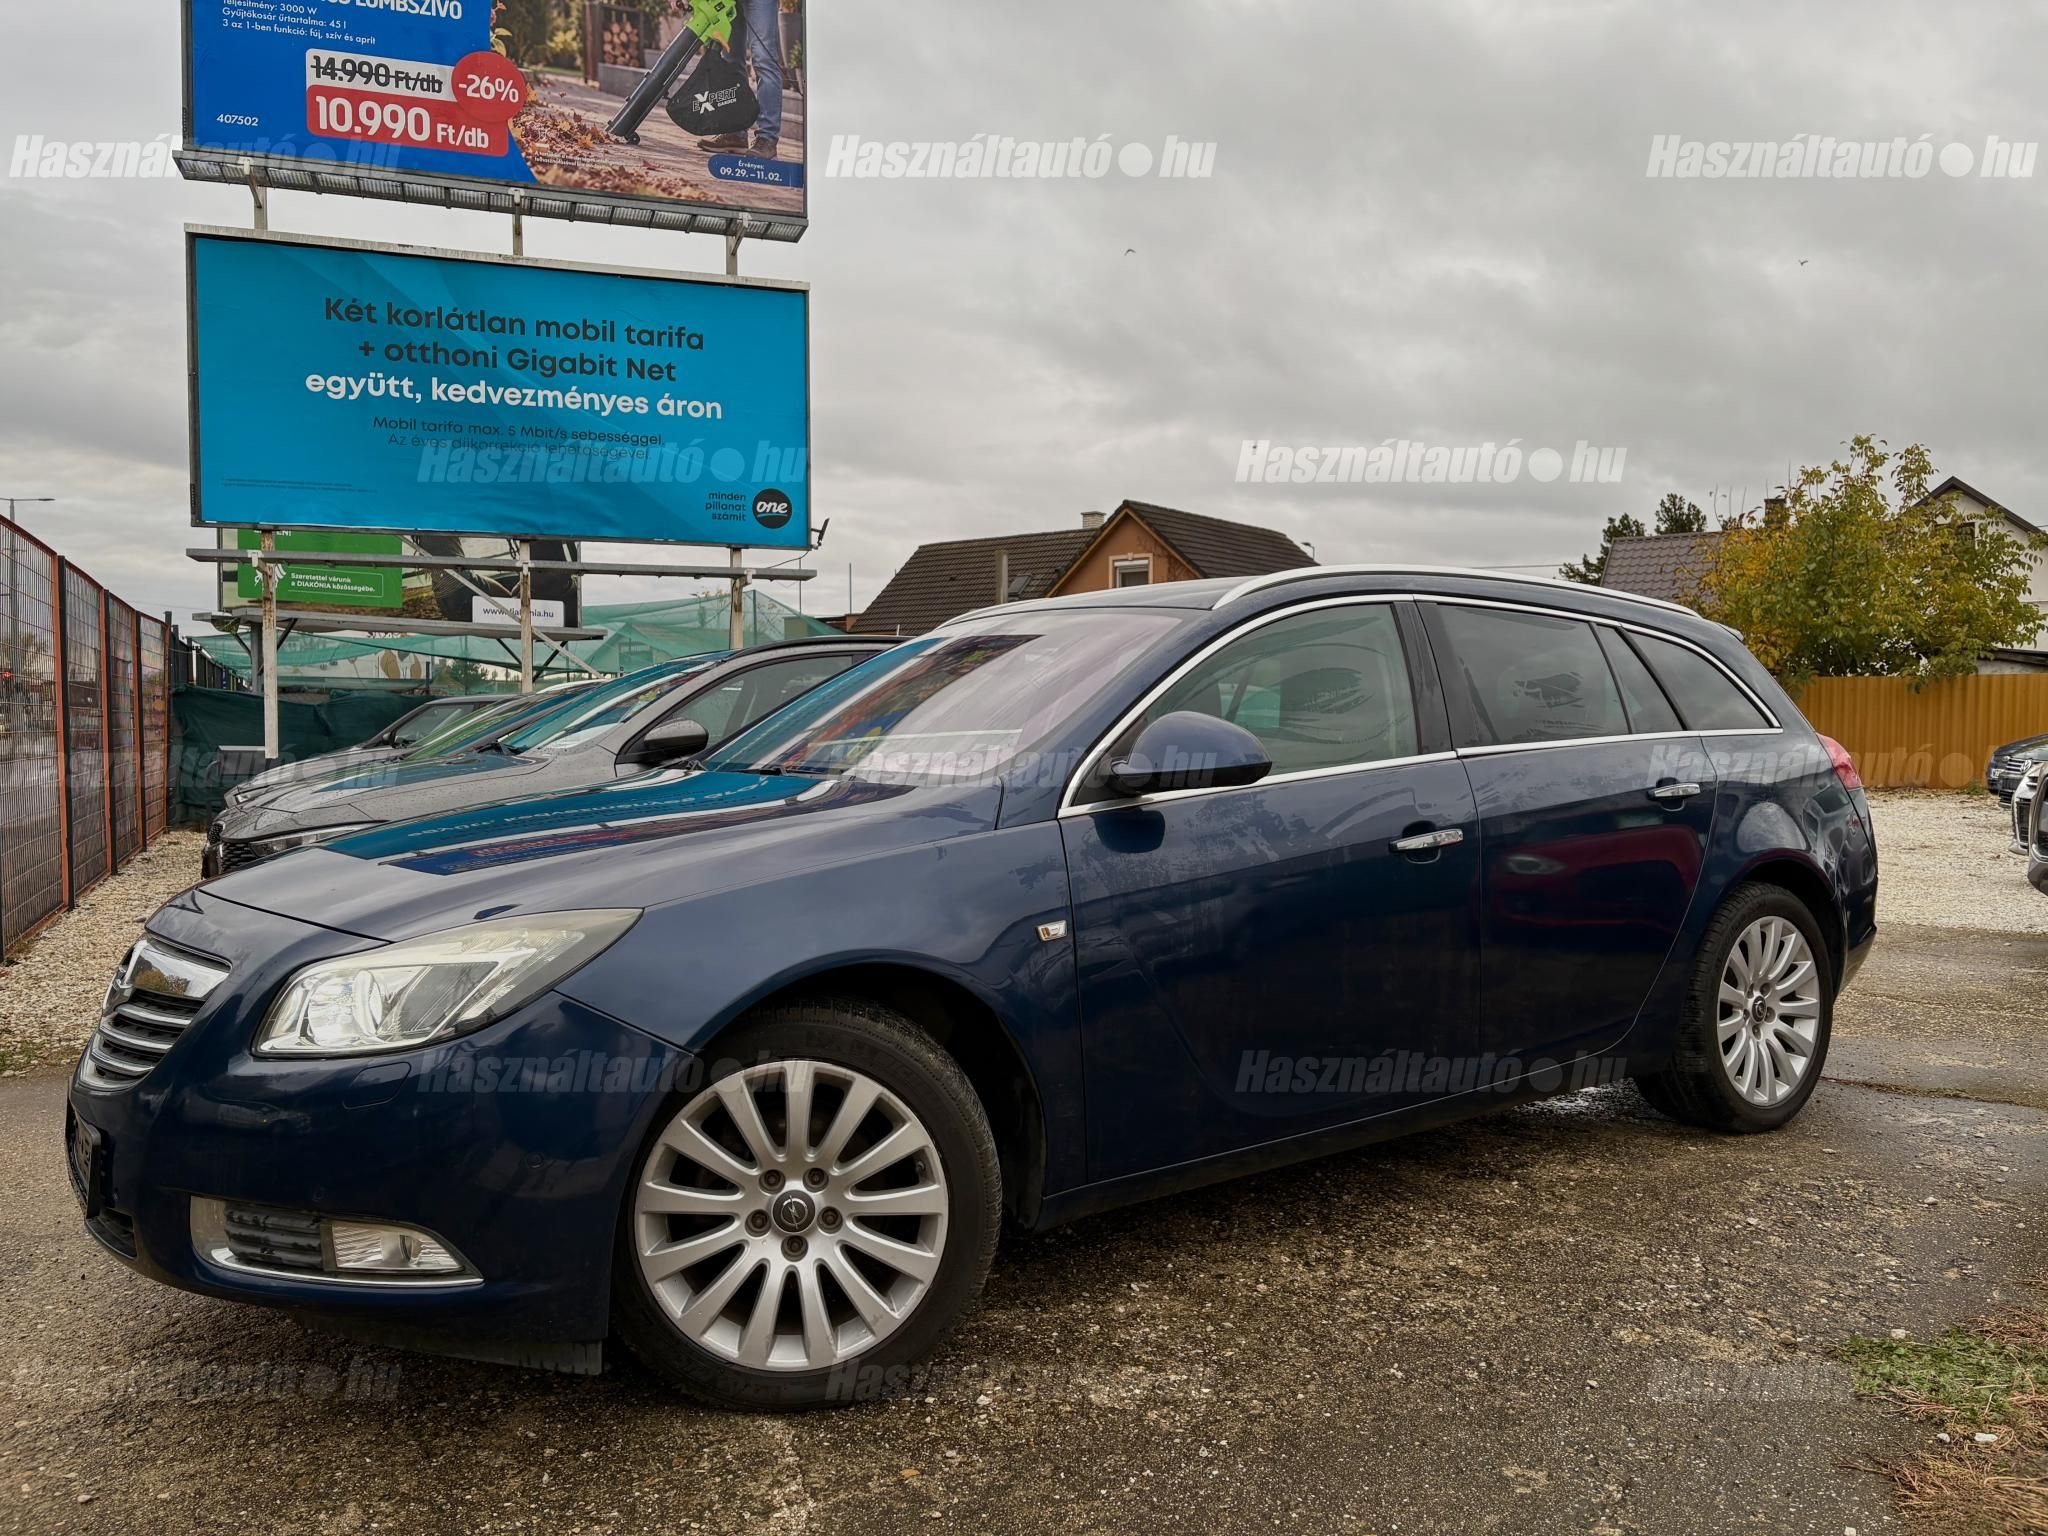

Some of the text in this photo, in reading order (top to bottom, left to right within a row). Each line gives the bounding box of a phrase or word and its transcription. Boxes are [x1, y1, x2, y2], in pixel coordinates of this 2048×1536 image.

[280, 3, 304, 13] 3000
[307, 7, 317, 15] W
[222, 18, 229, 27] 3
[231, 21, 243, 29] az
[246, 21, 272, 32] 1-ben
[273, 25, 308, 37] funkció:
[326, 31, 342, 40] szív
[344, 33, 353, 42] és
[329, 20, 341, 29] 45
[311, 55, 443, 94] 14.990 Ft/db
[458, 74, 520, 103] -26%
[216, 113, 259, 127] 407502
[316, 95, 489, 149] 10.990 Ft/db
[325, 296, 704, 351] Két korlátlan mobil tarifa
[358, 339, 676, 383] + otthoni Gigabit Net
[305, 371, 722, 420] együtt, kedvezményes áron
[373, 416, 665, 447] Mobil tarifa max. 5 Mbit/s sebességgel.
[388, 433, 407, 446] Az
[410, 434, 448, 449] éves
[708, 491, 746, 501] minden
[705, 501, 746, 512] pillanat
[756, 501, 788, 514] one
[711, 511, 746, 521] számít
[291, 572, 352, 584] Szeretettel várunk
[296, 579, 332, 589] DIAKÓNIA
